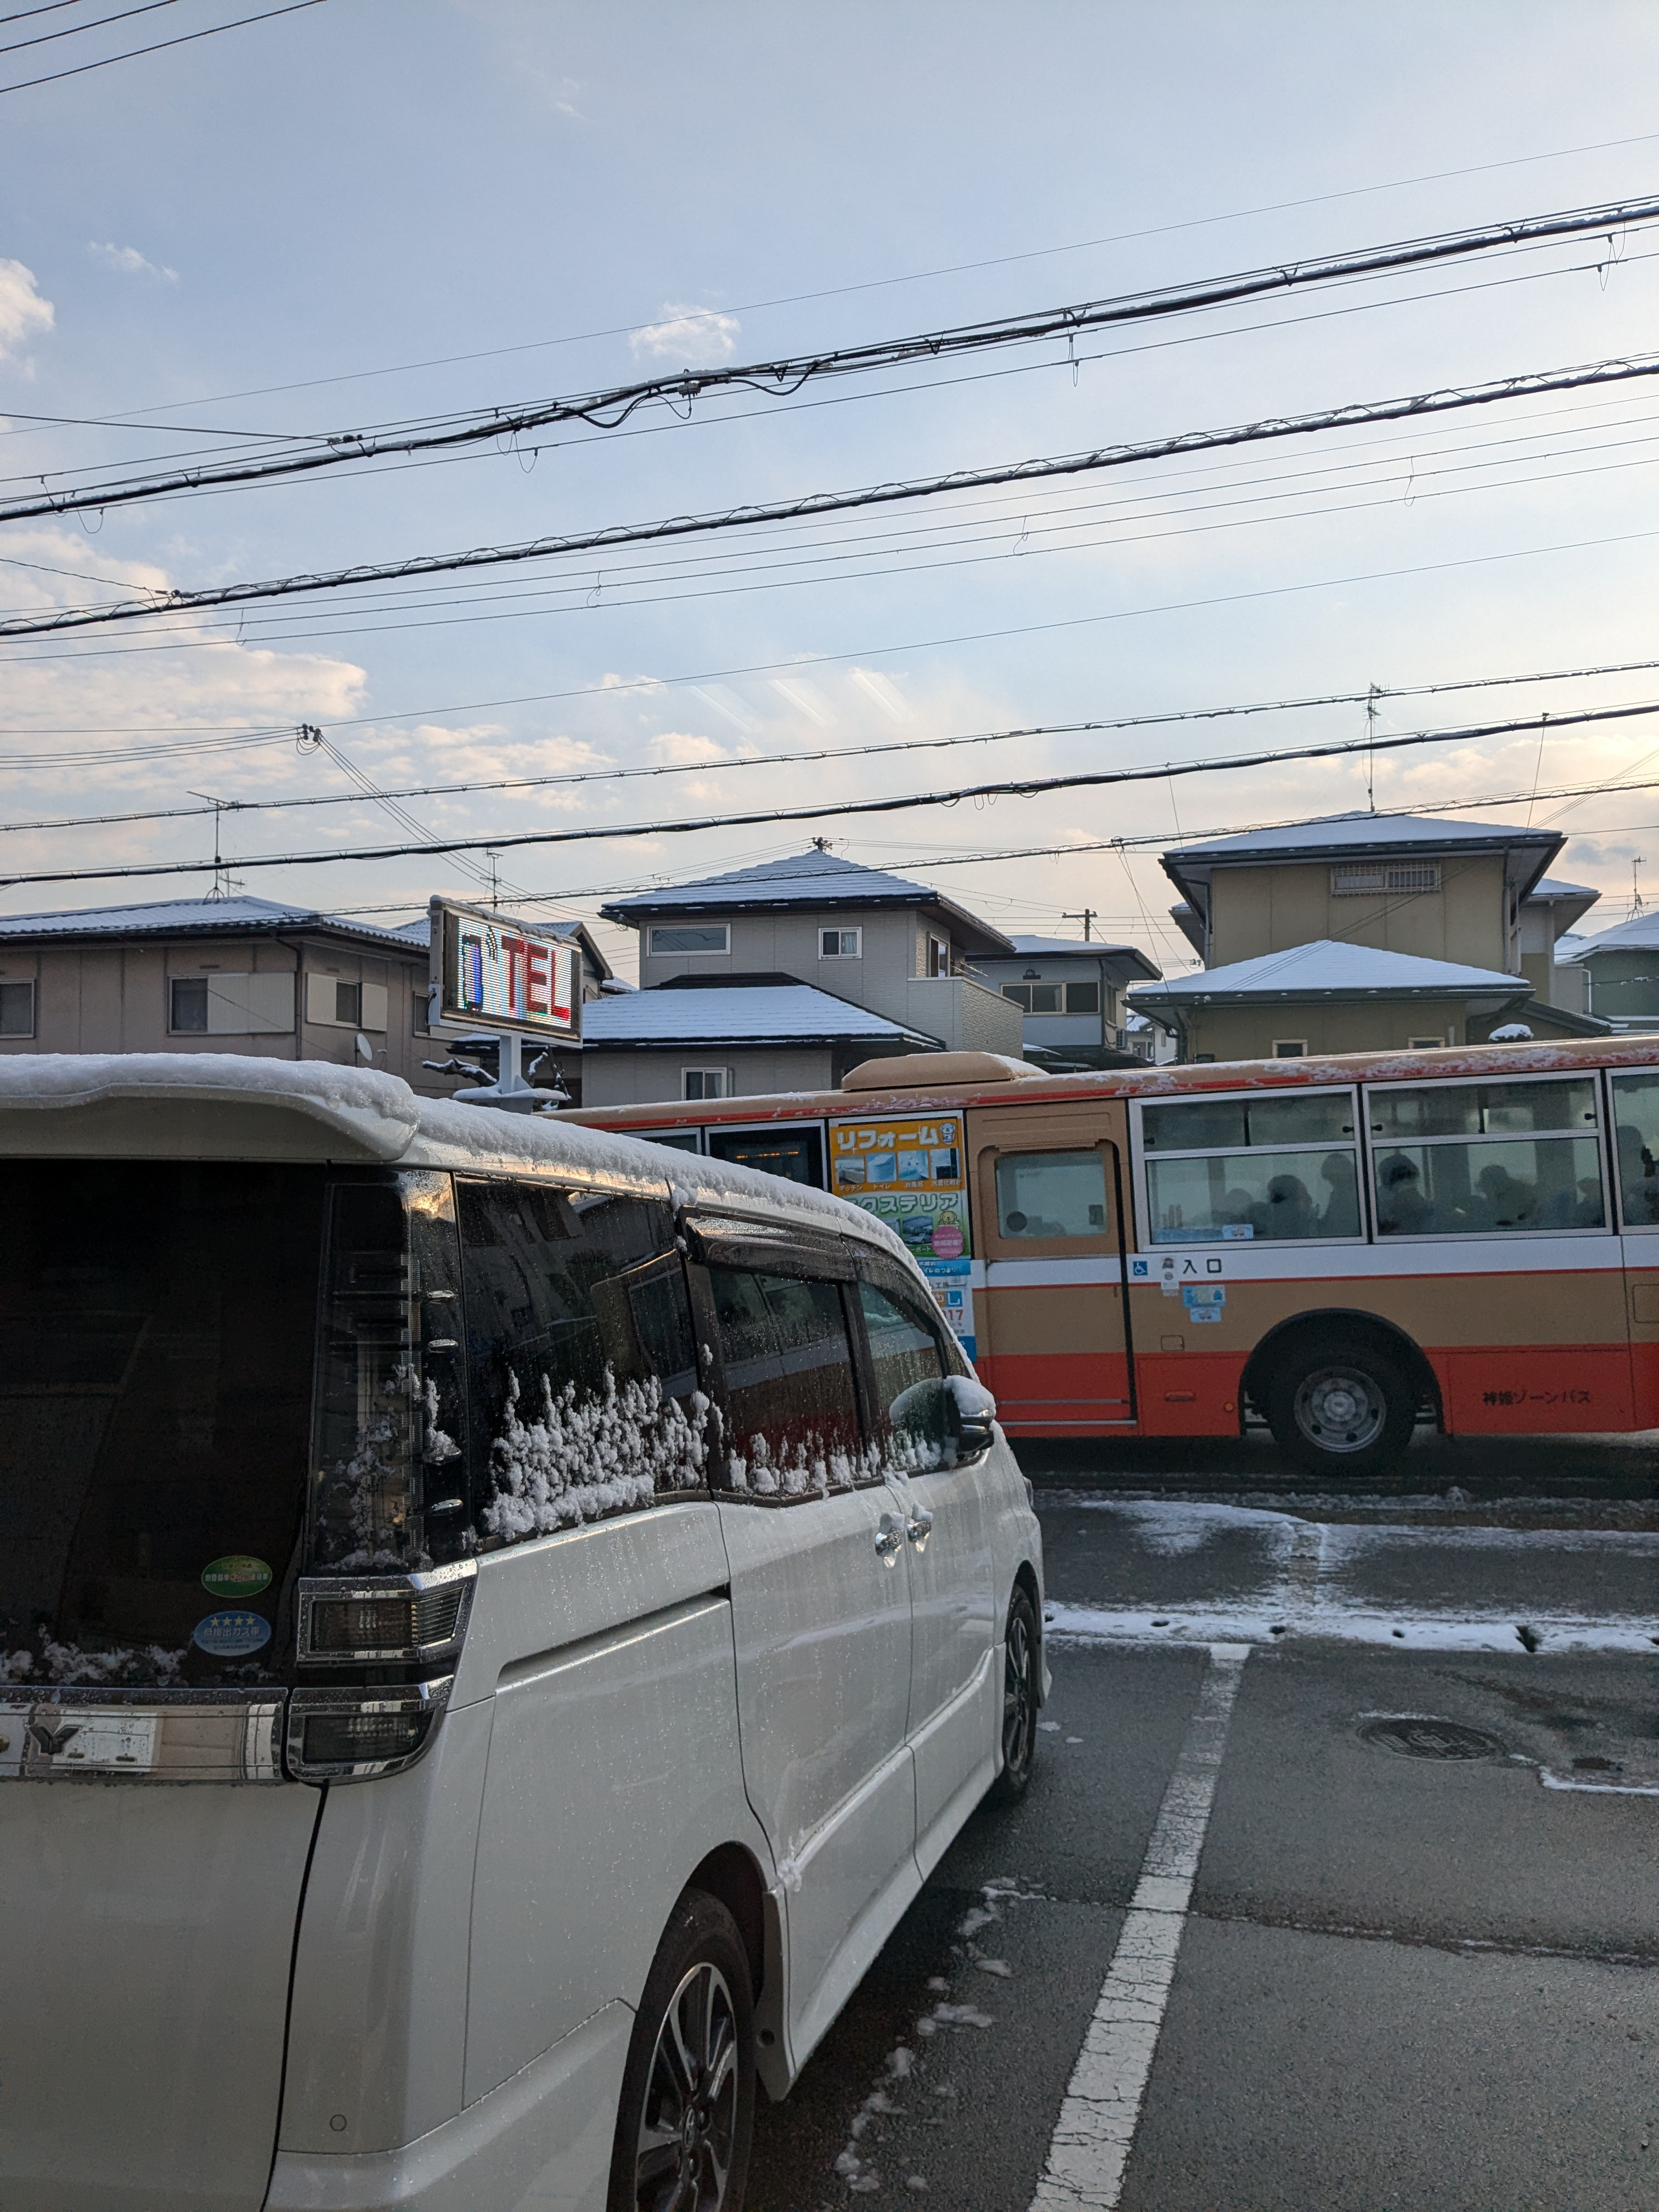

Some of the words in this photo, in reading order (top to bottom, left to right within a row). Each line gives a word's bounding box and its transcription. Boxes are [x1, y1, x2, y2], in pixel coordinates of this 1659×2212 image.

[837, 1126, 939, 1150] リフォーム
